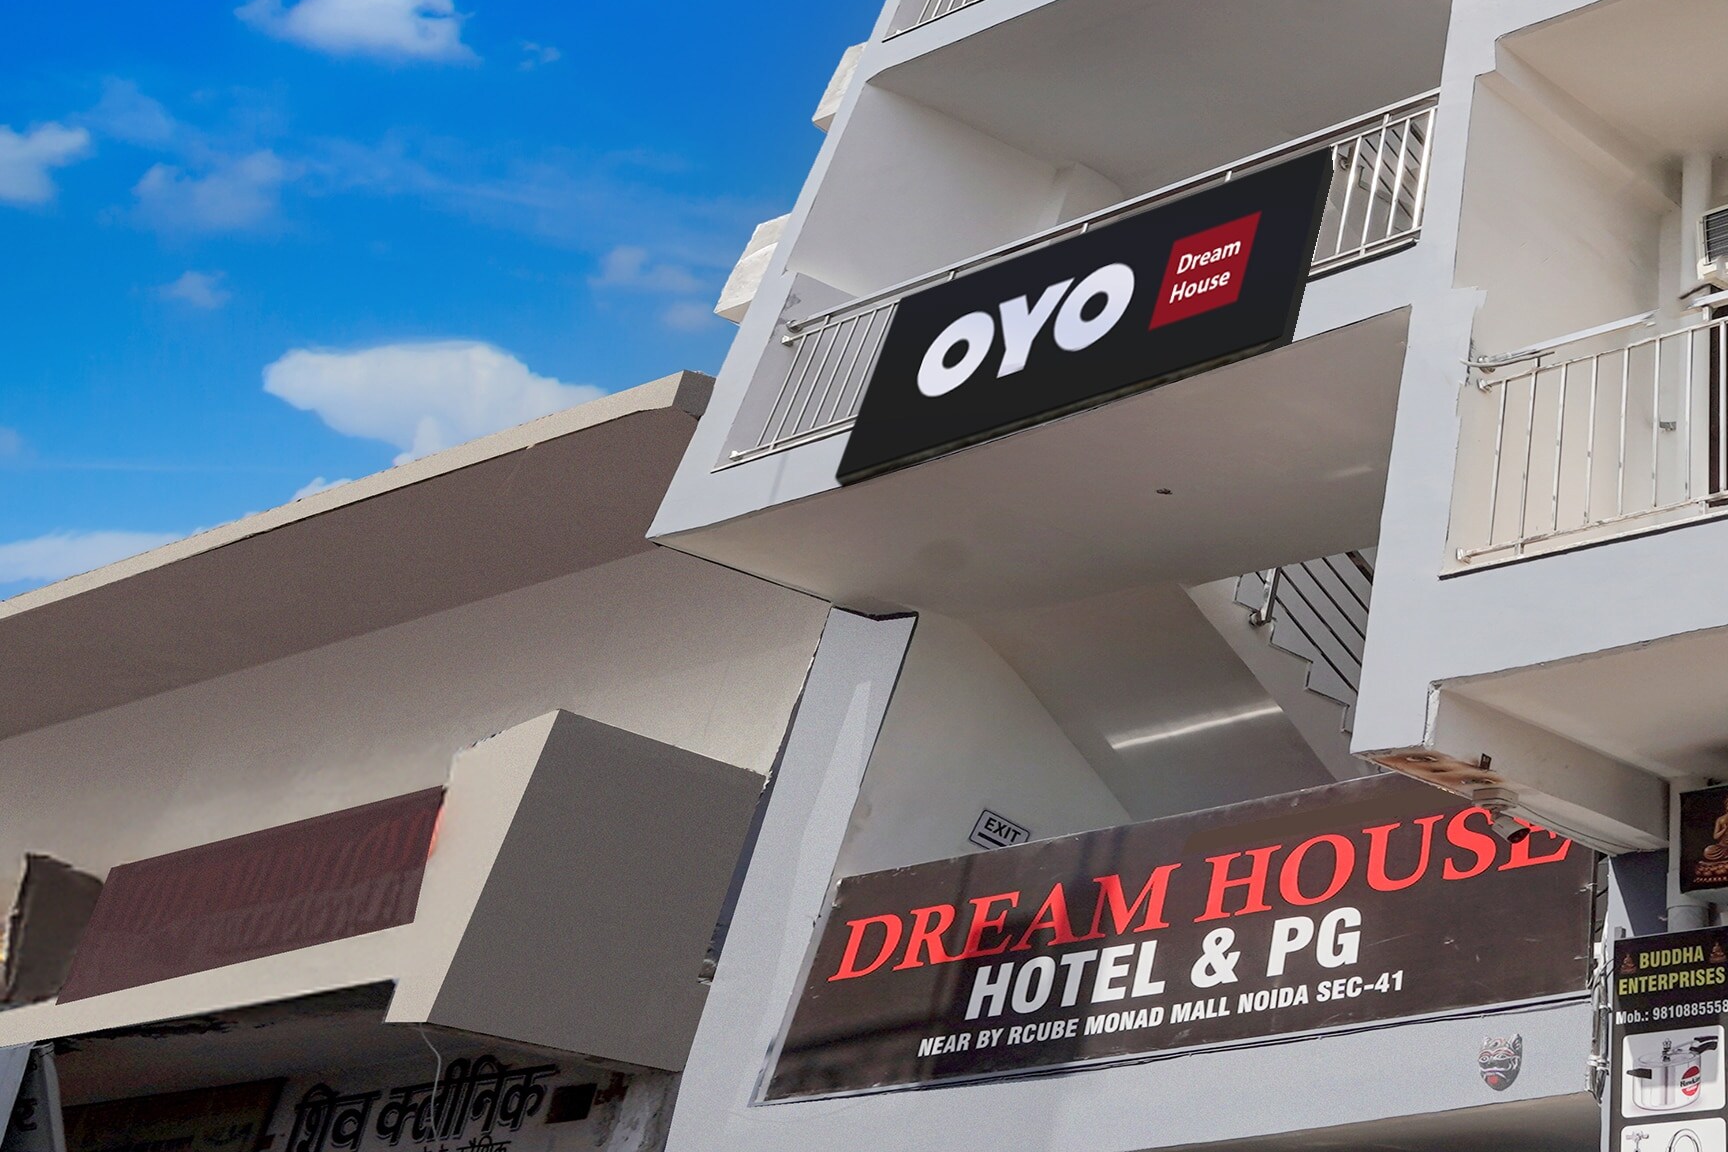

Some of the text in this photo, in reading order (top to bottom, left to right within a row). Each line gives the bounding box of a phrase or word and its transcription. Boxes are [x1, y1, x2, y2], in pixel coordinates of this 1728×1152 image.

[1176, 237, 1242, 275] Dream
[1169, 268, 1231, 305] House
[917, 262, 1136, 398] OYO
[984, 817, 1021, 843] EXIT
[827, 805, 1573, 983] DREAM HOUSE
[964, 906, 1362, 1022] HOTEL & PG
[1639, 945, 1705, 970] BUDDHA
[1618, 966, 1726, 996] ENTERPRISES
[918, 969, 1405, 1059] NEAR BY RCUBE MONAD MALL NOIDA SEC-41
[1615, 1009, 1649, 1027] Mob.:
[286, 1082, 381, 1152] शिव
